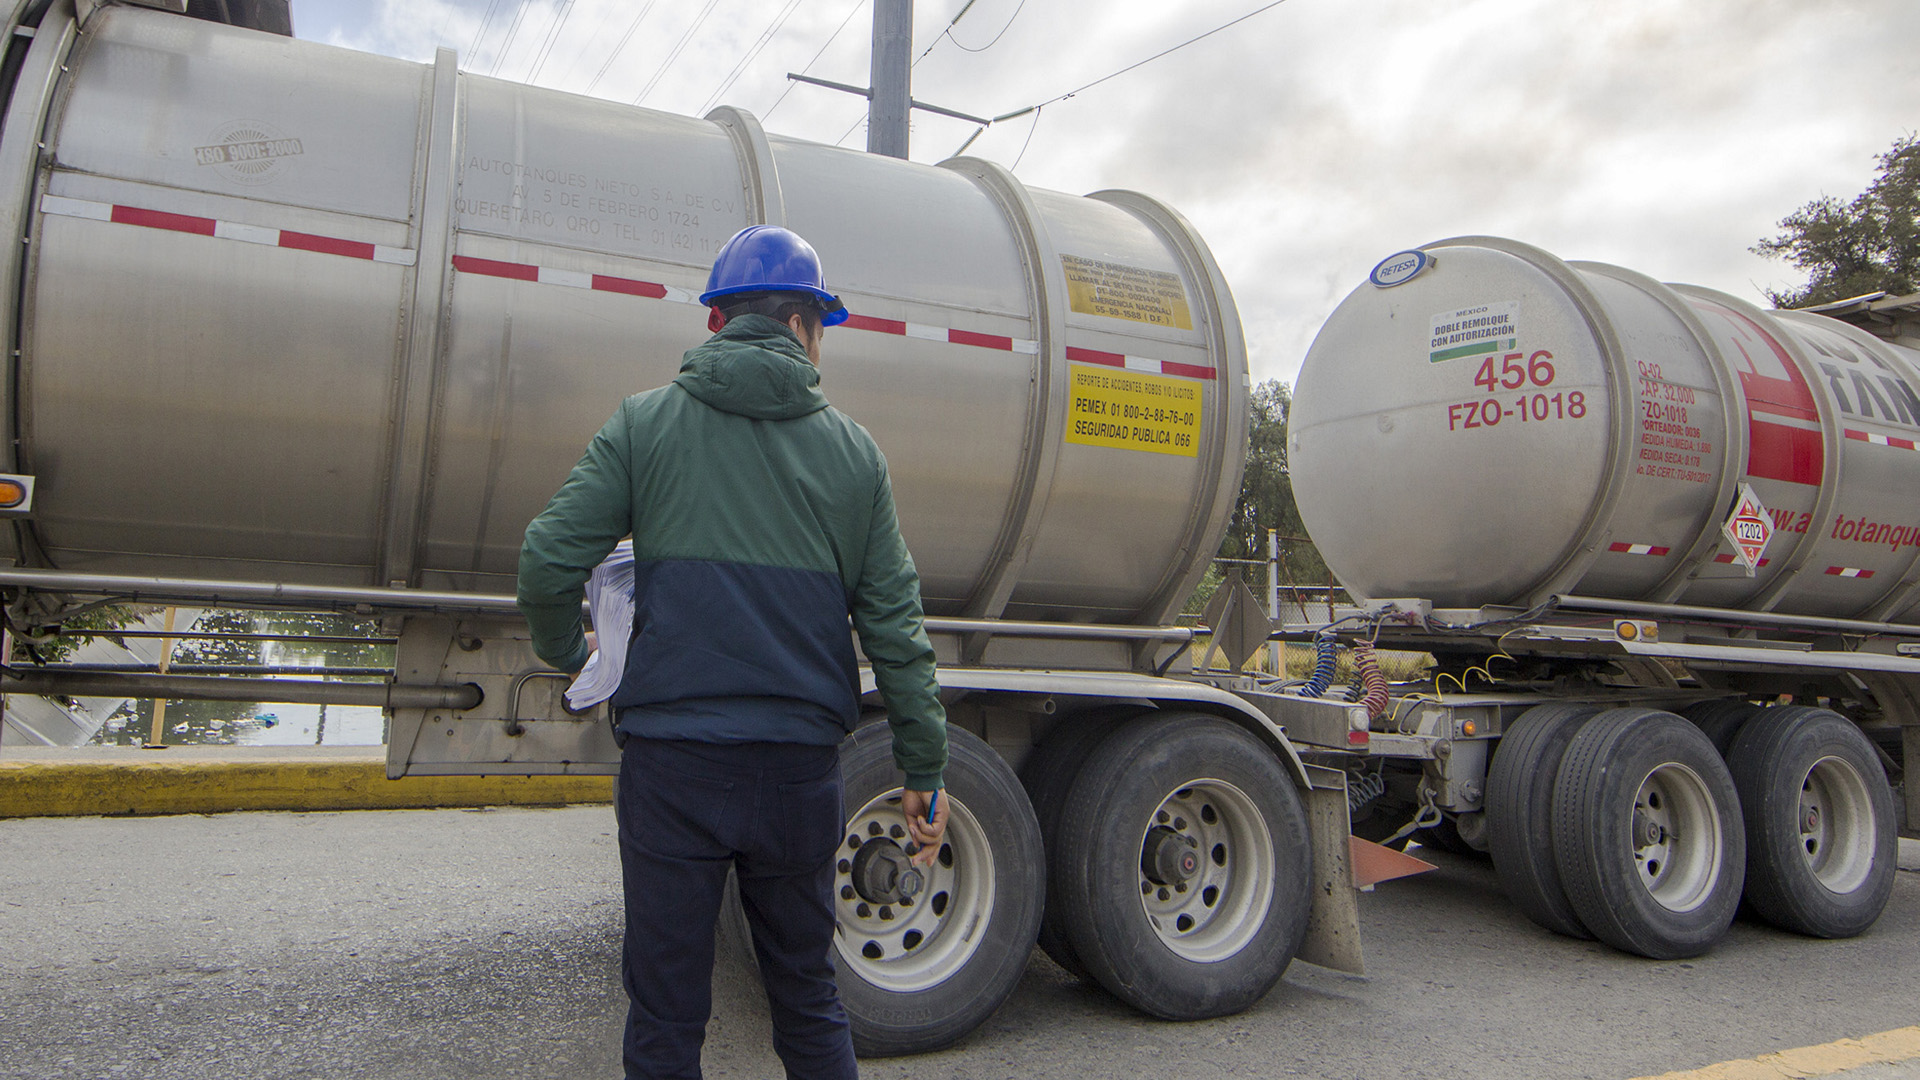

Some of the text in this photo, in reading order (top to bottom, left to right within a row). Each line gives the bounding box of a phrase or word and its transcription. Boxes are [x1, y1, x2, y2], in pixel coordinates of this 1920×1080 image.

[197, 139, 301, 164] ISO 9001:2000
[468, 156, 587, 189] AUTOTANQUES
[685, 193, 705, 209] DE
[543, 189, 552, 203] 5
[560, 192, 581, 209] DE
[588, 196, 659, 221] FEBRERO
[667, 211, 701, 228] 1724
[1379, 258, 1416, 279] RETESA
[1431, 324, 1515, 348] CON AUTORIZACIÓN
[1435, 314, 1509, 336] DOBLE REMOLQUE
[1474, 350, 1556, 392] 456
[1635, 360, 1664, 380] Q-02
[1075, 397, 1194, 426] PEMEX 01 800-2-88-76-00
[1448, 391, 1587, 431] FZO-1018
[1074, 420, 1191, 447] SEGURIDAD PUBLICA 066
[1738, 522, 1762, 540] 1202
[1748, 547, 1755, 561] 3
